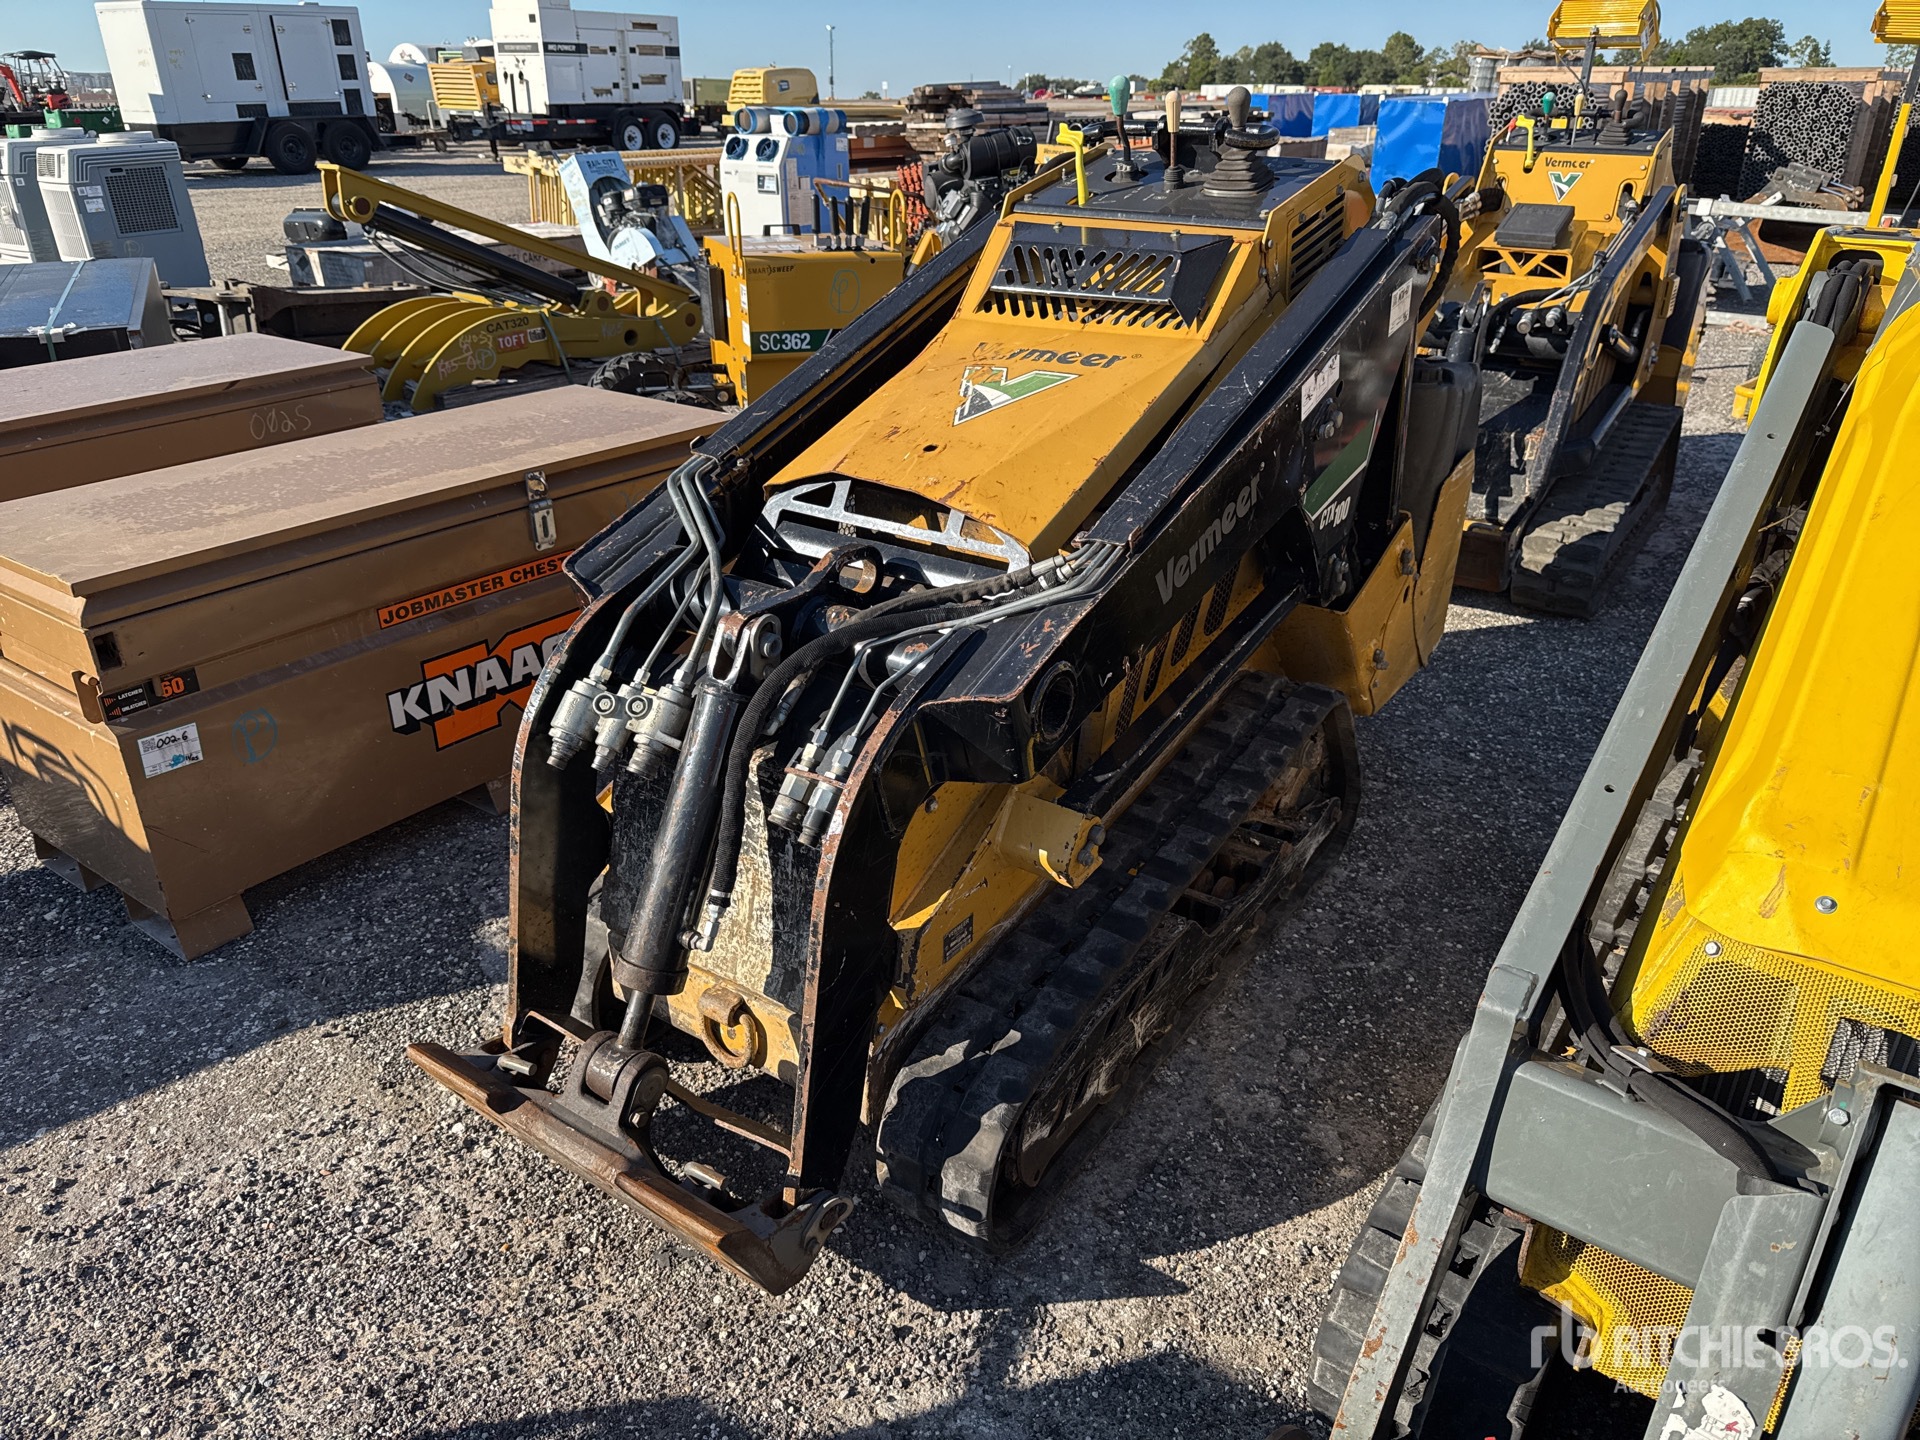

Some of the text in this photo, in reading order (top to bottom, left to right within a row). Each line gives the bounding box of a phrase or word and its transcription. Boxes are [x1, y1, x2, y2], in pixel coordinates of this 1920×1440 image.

[486, 316, 529, 333] CAT320
[760, 333, 811, 350] SC362
[1155, 473, 1260, 605] Vermeer
[383, 575, 505, 625] JOBMASTER
[118, 688, 143, 700] LATCHED
[121, 700, 147, 712] UNLATCHED
